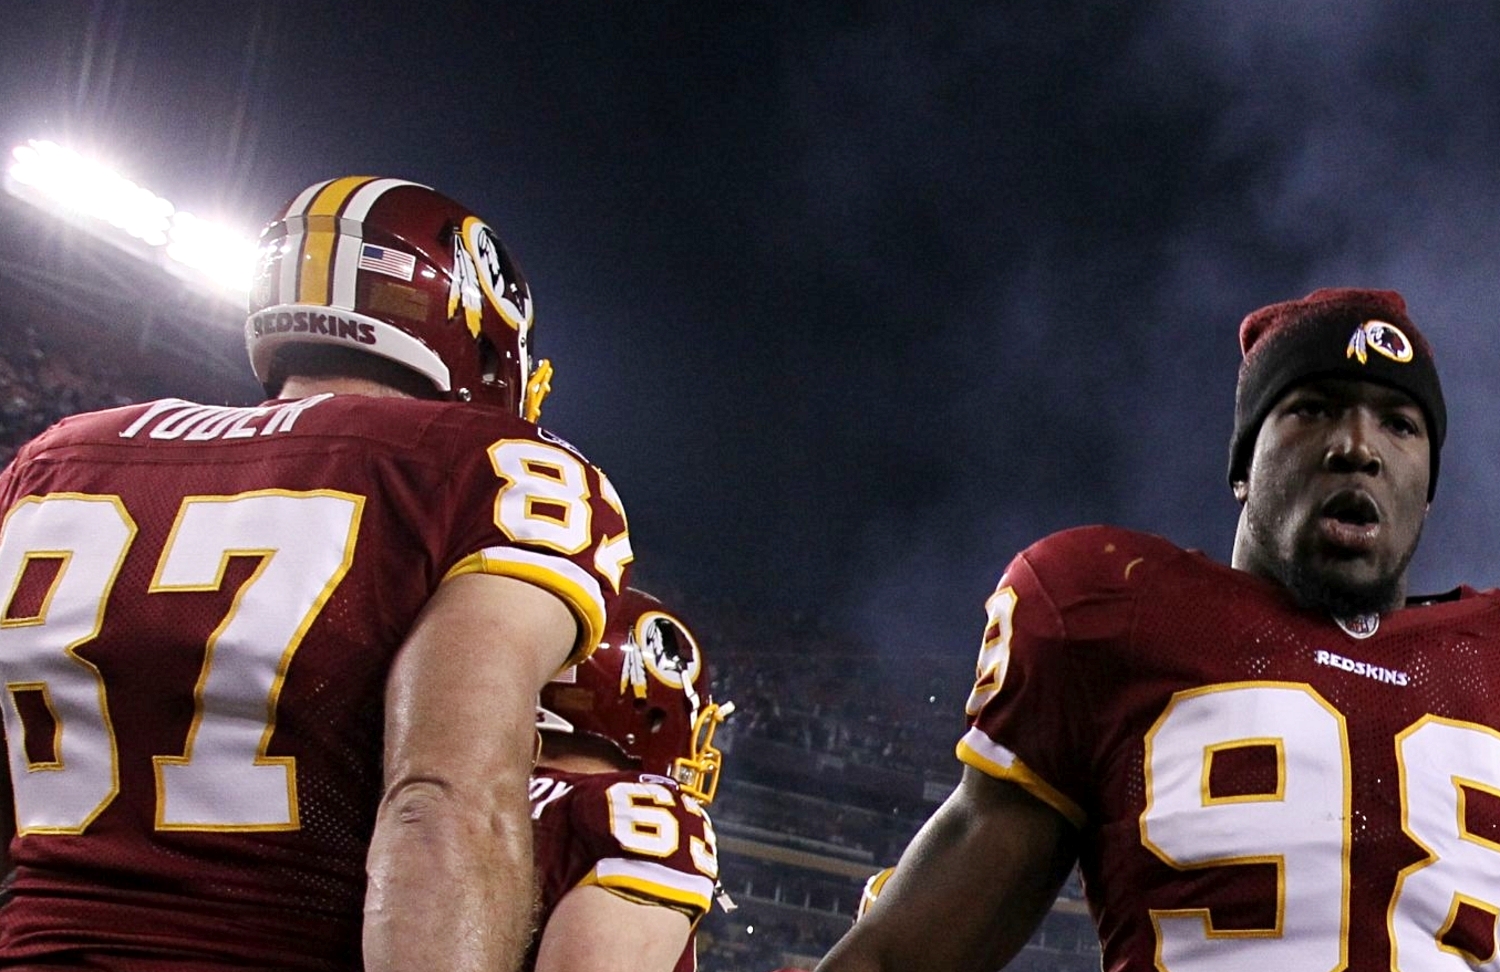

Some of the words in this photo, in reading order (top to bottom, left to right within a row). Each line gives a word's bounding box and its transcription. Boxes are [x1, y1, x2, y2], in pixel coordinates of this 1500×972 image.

[253, 312, 376, 346] REDSKINS
[0, 488, 366, 838] 87
[1315, 650, 1410, 687] REDSKINS
